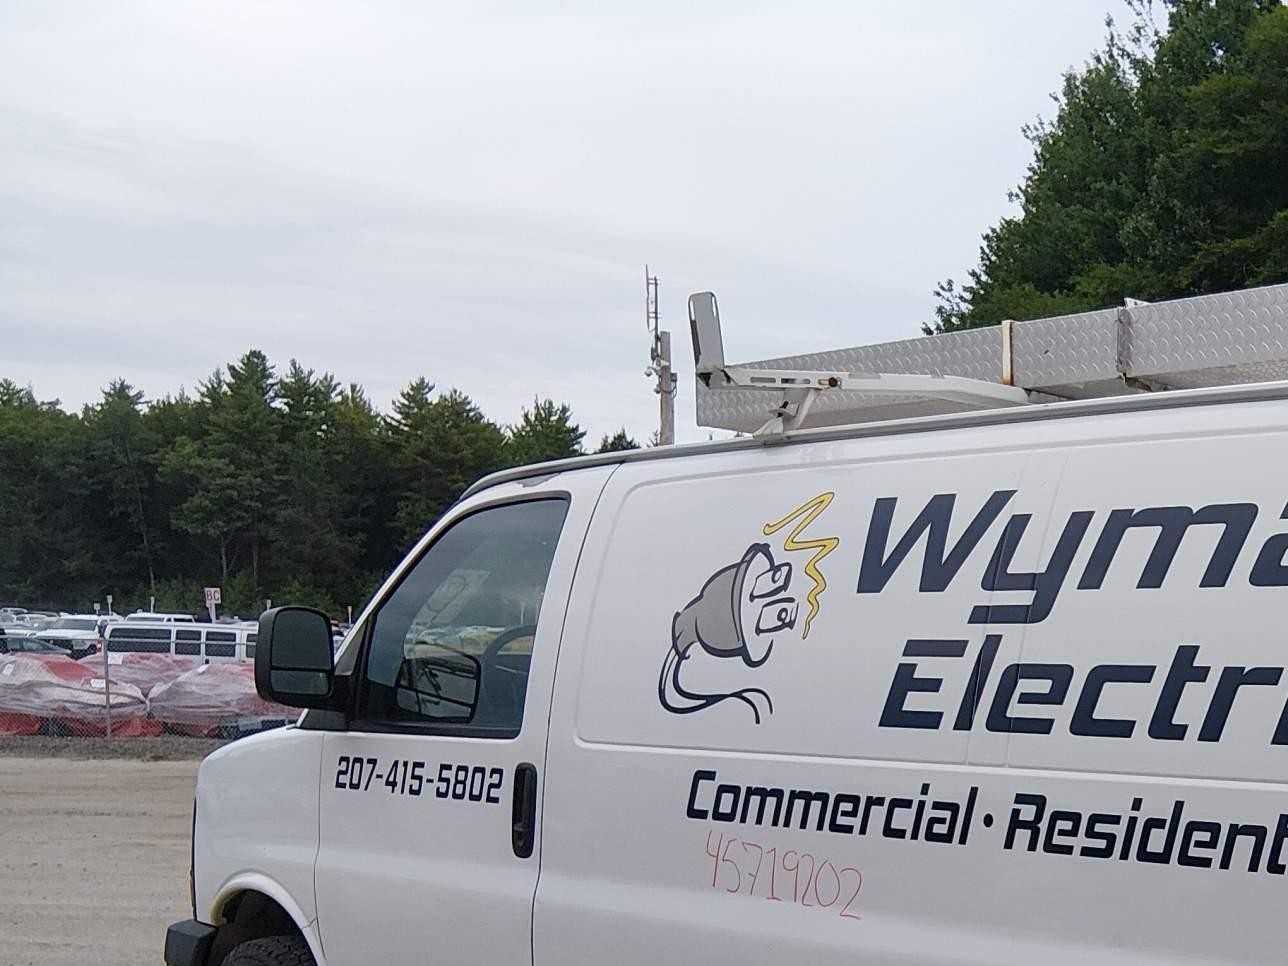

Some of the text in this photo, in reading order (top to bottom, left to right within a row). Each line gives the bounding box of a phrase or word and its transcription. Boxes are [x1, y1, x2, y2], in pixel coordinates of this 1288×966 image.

[206, 590, 220, 601] BC
[335, 756, 504, 804] 207-415-5802
[687, 769, 979, 847] Commercial
[706, 829, 862, 920] 45719202
